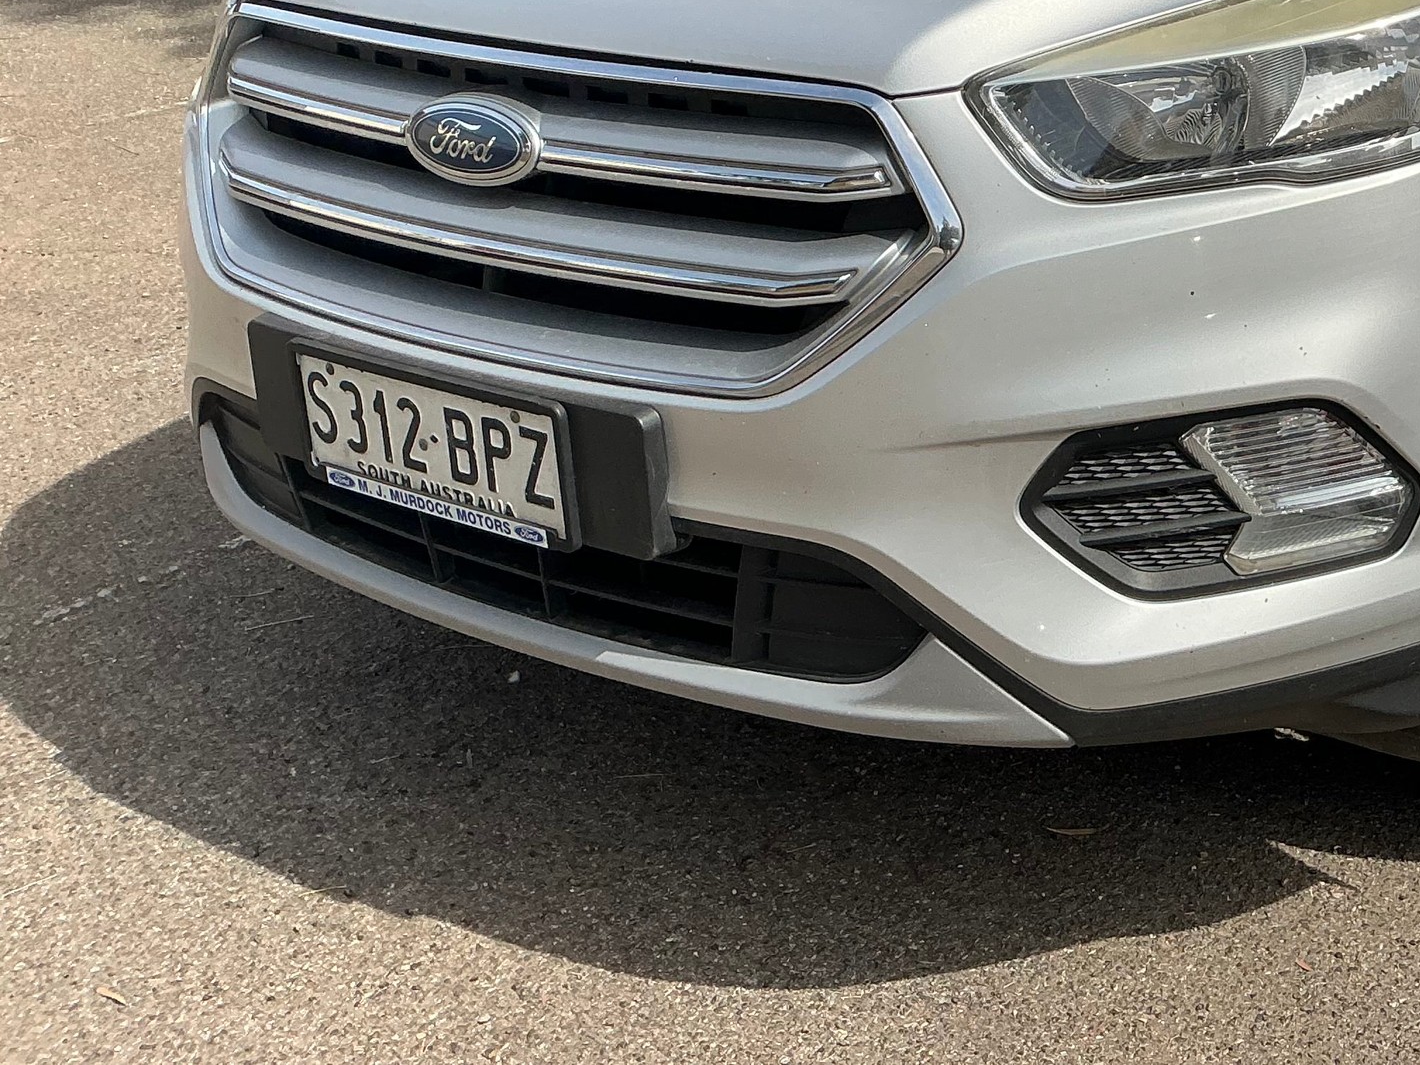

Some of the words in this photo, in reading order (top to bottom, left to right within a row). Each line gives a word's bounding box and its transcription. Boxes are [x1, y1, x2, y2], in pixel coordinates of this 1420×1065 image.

[429, 117, 497, 164] Ford
[357, 461, 413, 490] SOUTH
[420, 479, 518, 519] AUSTRALIA
[357, 479, 373, 494] M.
[376, 485, 387, 499] J.
[390, 488, 453, 519] MURDOCK
[456, 507, 512, 535] MOTORS
